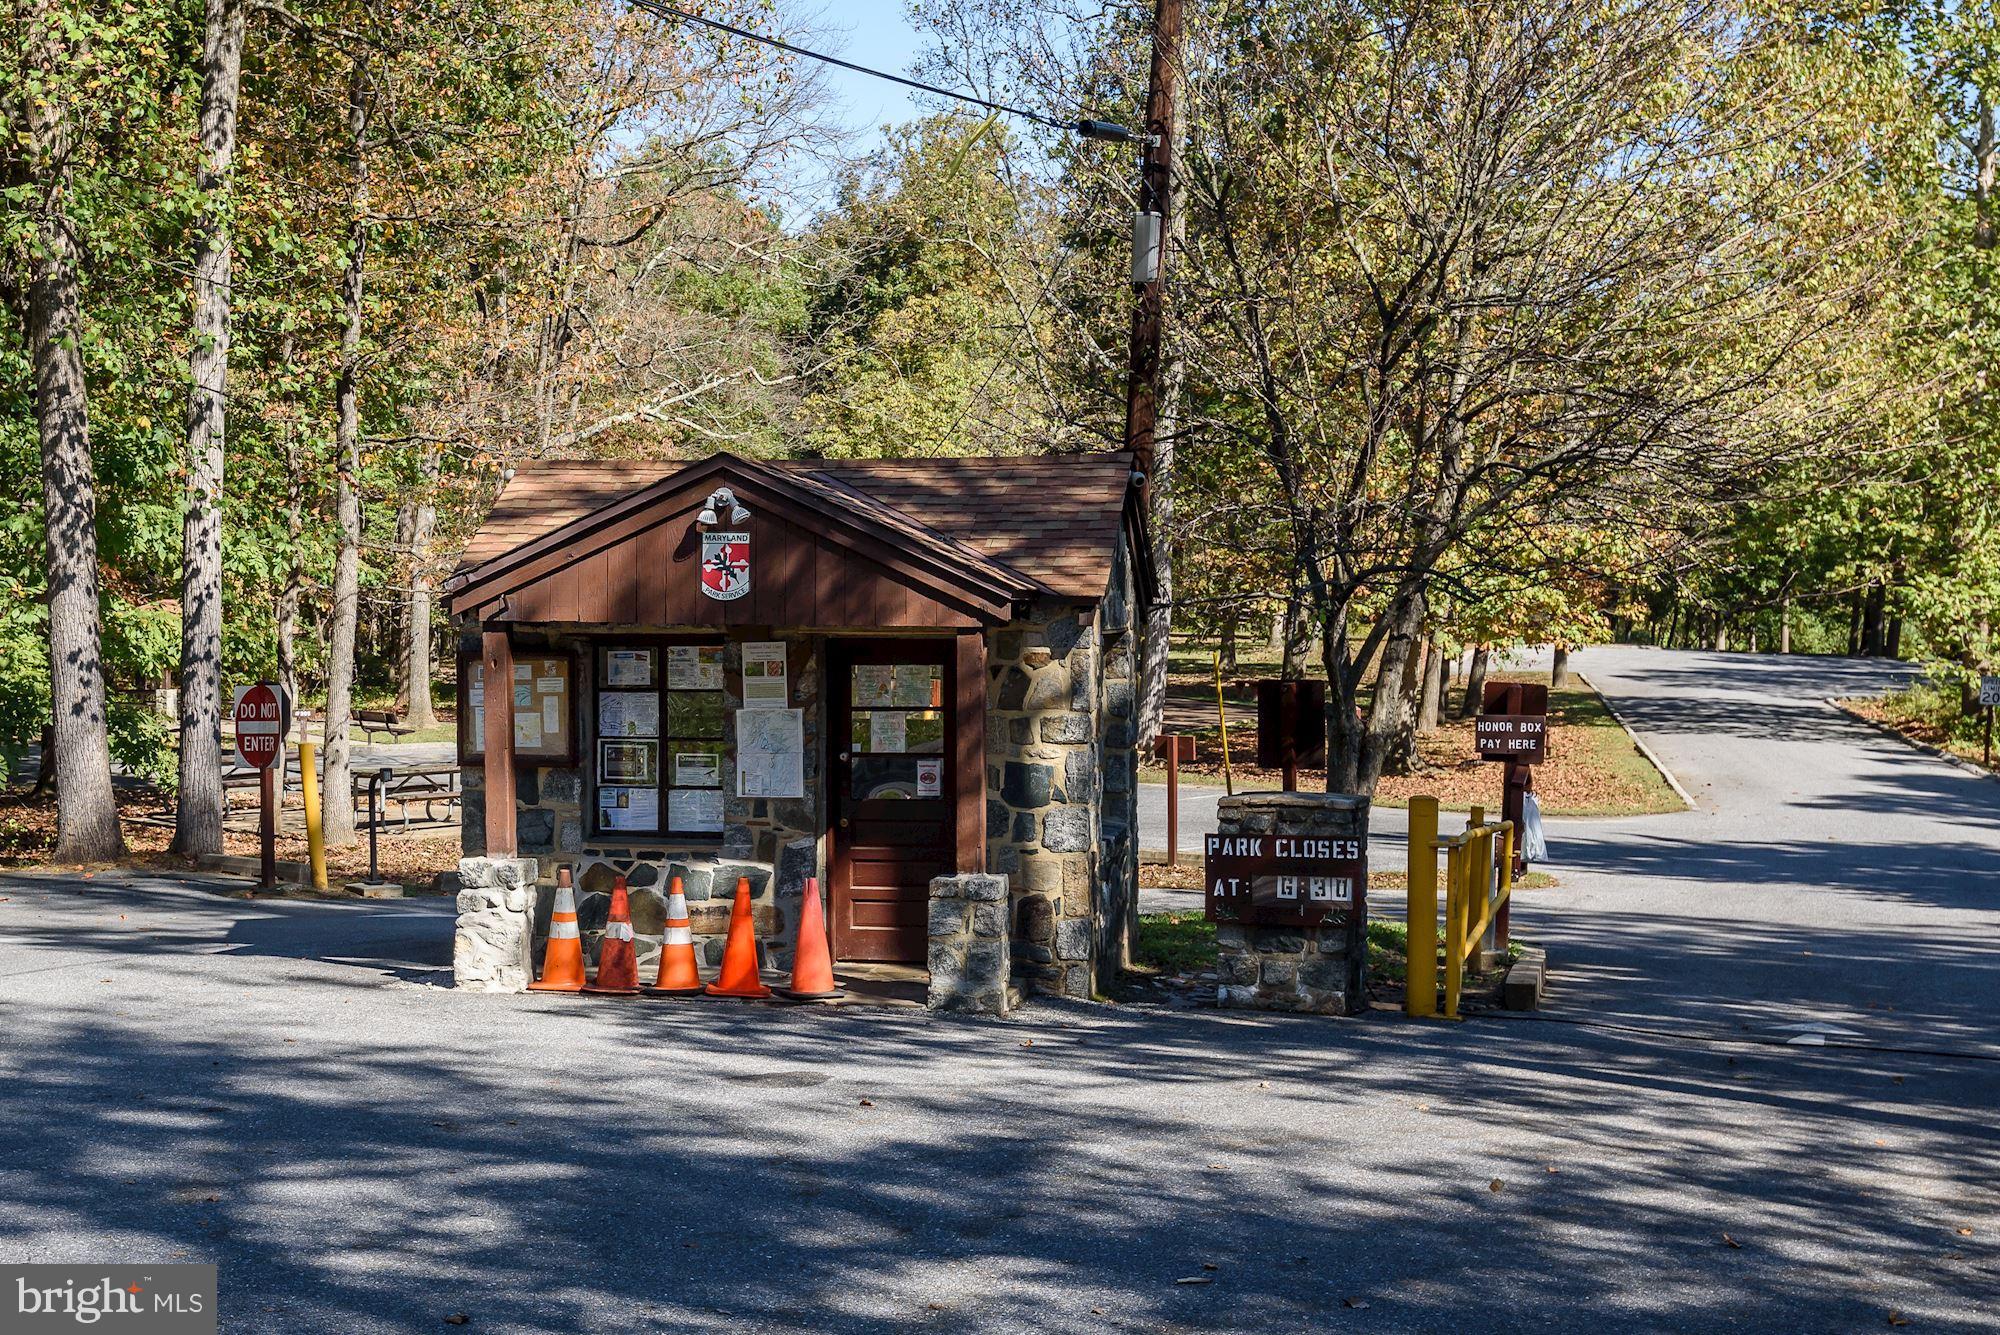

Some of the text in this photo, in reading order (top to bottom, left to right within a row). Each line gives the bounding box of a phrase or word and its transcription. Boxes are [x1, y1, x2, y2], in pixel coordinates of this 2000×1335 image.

[704, 533, 748, 542] MARYLAND
[704, 587, 746, 599] PARK SERVICE
[1982, 692, 2000, 704] 20
[240, 703, 276, 719] DO NOT
[1478, 721, 1542, 733] HONOR BOX
[244, 736, 275, 752] ENTER
[1480, 738, 1537, 750] PAY HERE
[1207, 837, 1359, 860] PARK CLOSES
[1213, 878, 1250, 897] AT:
